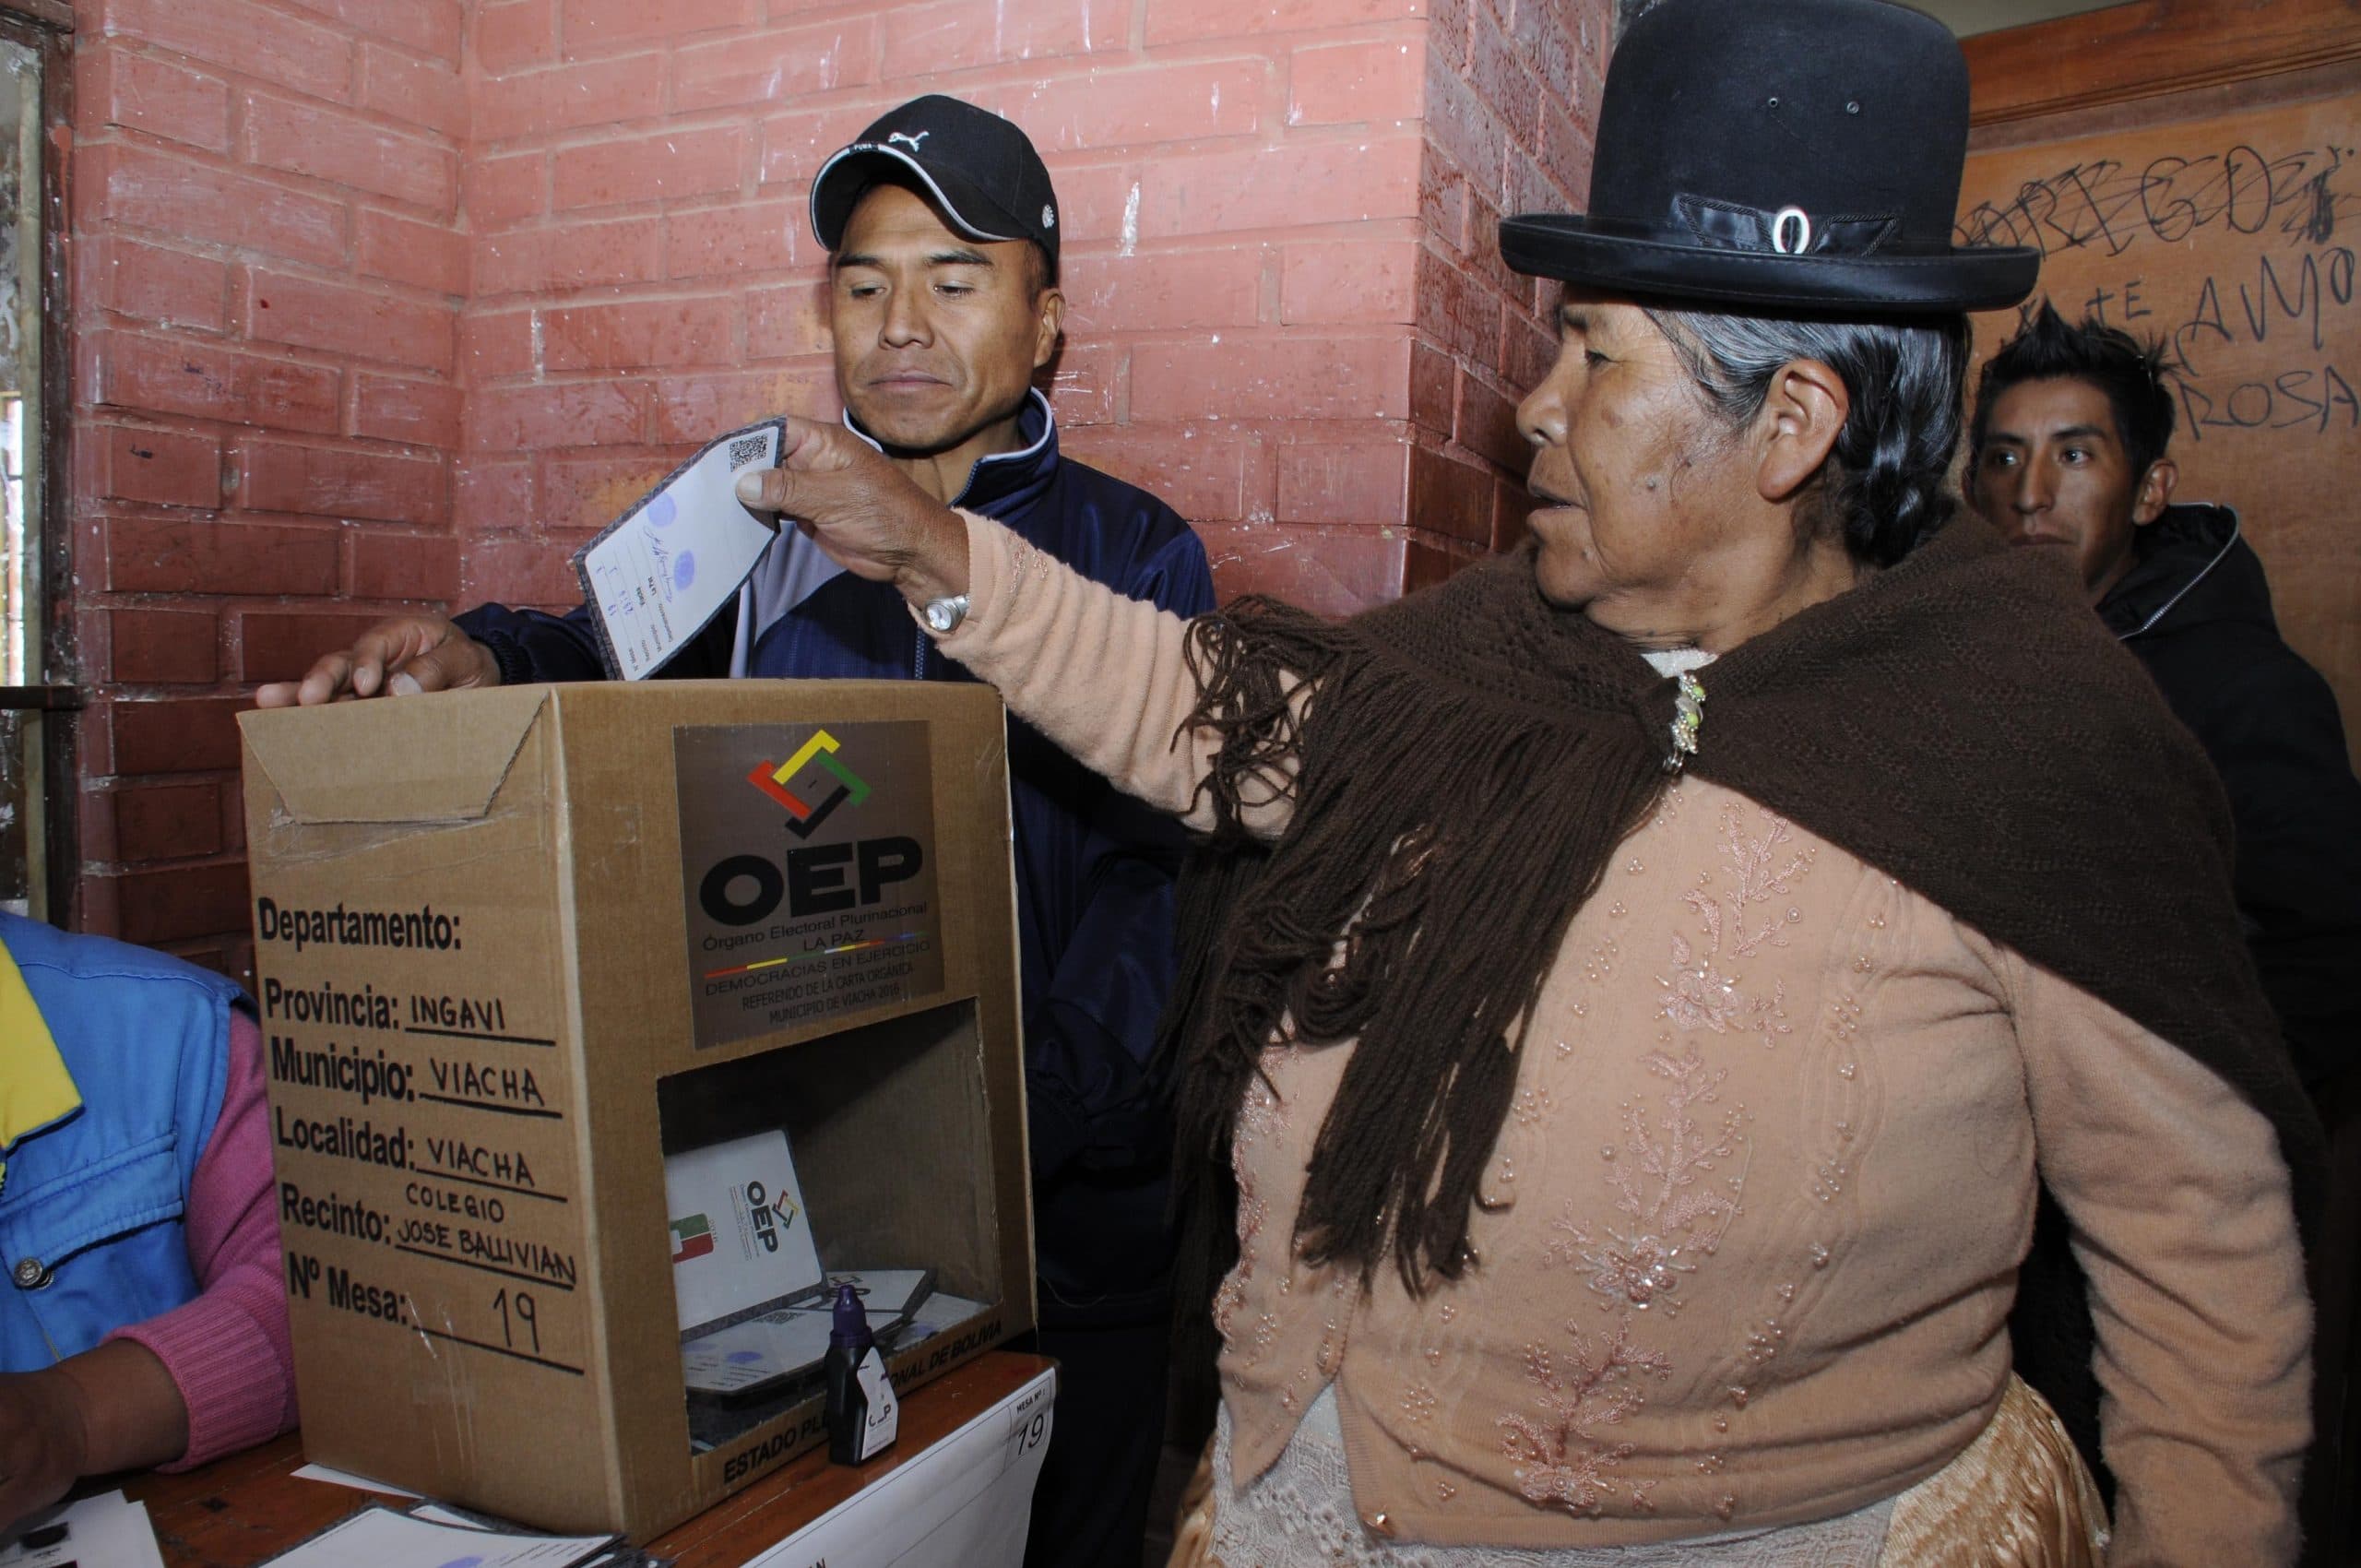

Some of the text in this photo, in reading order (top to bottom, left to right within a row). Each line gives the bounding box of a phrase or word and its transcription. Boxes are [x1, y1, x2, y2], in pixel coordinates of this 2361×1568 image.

[2171, 365, 2360, 442] ROSA
[699, 836, 923, 927] OEP
[257, 897, 462, 952] Departamento:
[703, 901, 928, 952] Órgano Electoral Plurinacional
[802, 929, 866, 952] LA PAZ
[705, 940, 931, 997] DEMOCRACIAS EN EJERCICIO
[742, 984, 804, 1011] REFERENDO
[805, 980, 820, 996] DE
[822, 978, 835, 993] LA
[835, 973, 865, 992] CARTA
[265, 978, 400, 1030] Provincia:
[410, 995, 506, 1031] INGAVI
[768, 1001, 825, 1025] MUNICIPIO
[826, 995, 840, 1011] DE
[841, 988, 877, 1008] VIACHA
[271, 1035, 415, 1105] Municipio:
[429, 1057, 545, 1107] VIACHA
[277, 1106, 416, 1170] Localidad:
[427, 1137, 536, 1187] VIACHA
[281, 1182, 391, 1245] Recinto:
[405, 1182, 505, 1223] COLEGIO
[747, 1181, 778, 1253] OEP
[397, 1219, 576, 1286] JOSE BALLIVIAN
[327, 1265, 408, 1324] Mesa:
[492, 1288, 540, 1353] 19
[722, 1426, 798, 1485] ESTADO
[930, 1346, 950, 1371] DE
[951, 1320, 1003, 1358] BOLIVIA
[1016, 1396, 1034, 1415] MESA
[1017, 1412, 1045, 1456] 19
